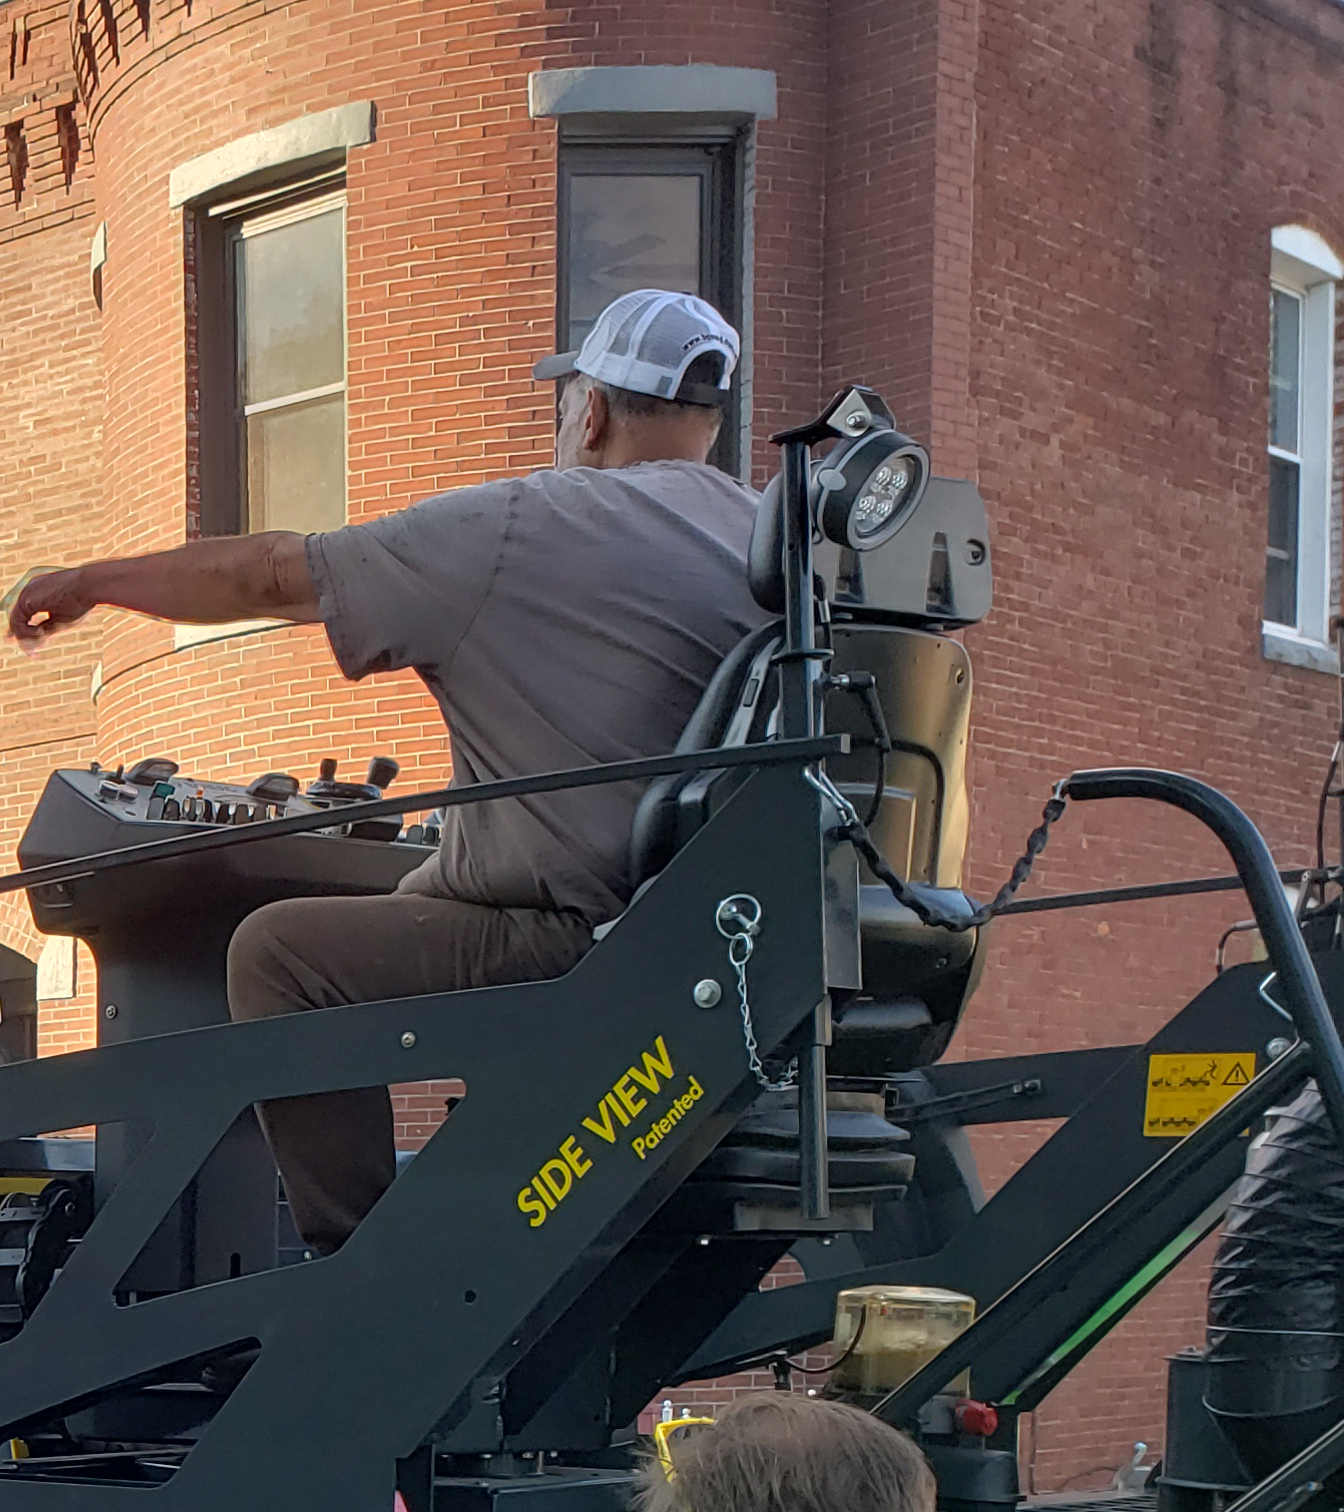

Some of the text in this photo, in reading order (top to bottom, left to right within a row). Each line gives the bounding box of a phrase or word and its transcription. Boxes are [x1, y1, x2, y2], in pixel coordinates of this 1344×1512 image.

[516, 1034, 675, 1228] SIDE VIEW
[630, 1074, 705, 1161] Patented
